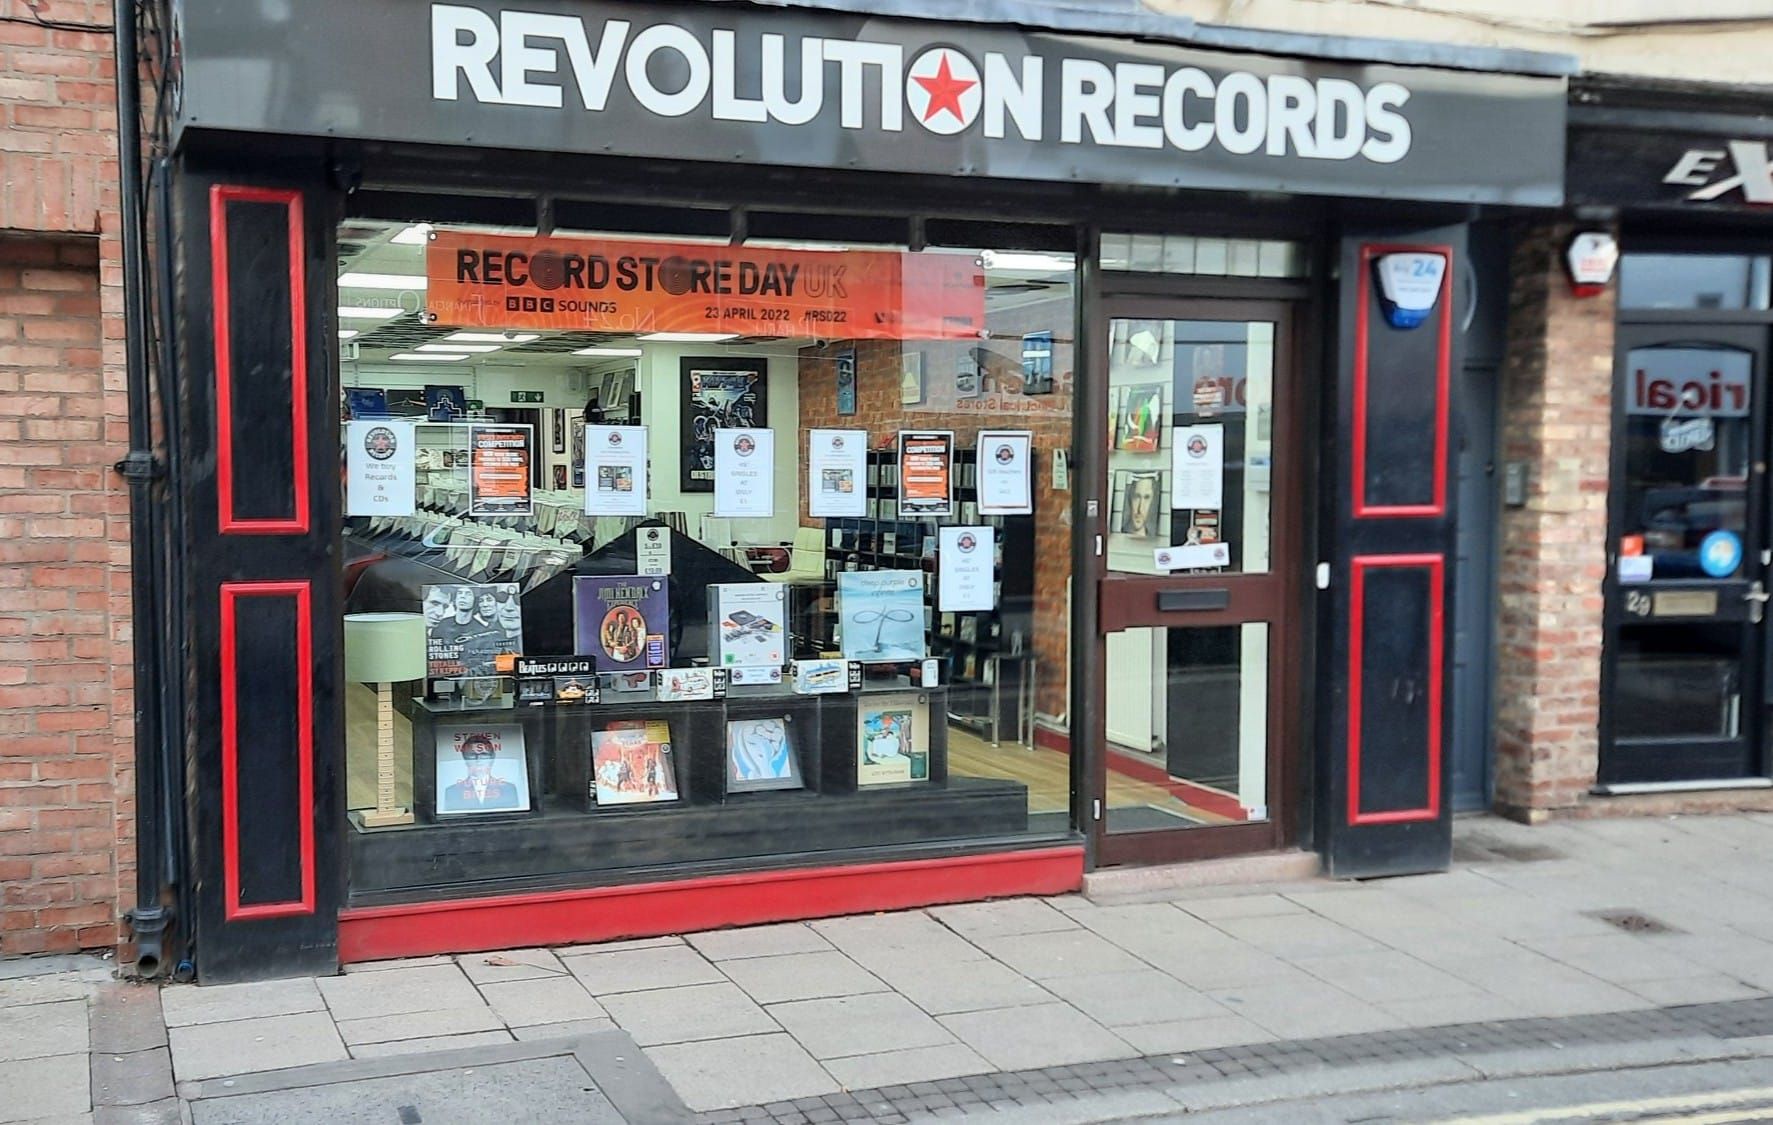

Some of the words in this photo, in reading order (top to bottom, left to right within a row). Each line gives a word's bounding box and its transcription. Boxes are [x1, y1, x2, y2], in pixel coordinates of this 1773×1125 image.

[431, 3, 1044, 142] REVOLUTION
[1061, 57, 1412, 164] RECORDS
[456, 248, 610, 291] RECORD
[616, 256, 732, 296] STORE
[738, 260, 799, 297] DAY
[803, 263, 849, 299] UK
[506, 296, 554, 313] BBC
[558, 299, 617, 314] SOUNDS
[705, 306, 720, 319] 23
[723, 307, 757, 321] APRIL
[760, 308, 791, 321] 2022
[803, 309, 847, 323] #RSD22
[364, 473, 398, 481] Records
[372, 494, 389, 503] CDs
[429, 645, 465, 654] ROLLING
